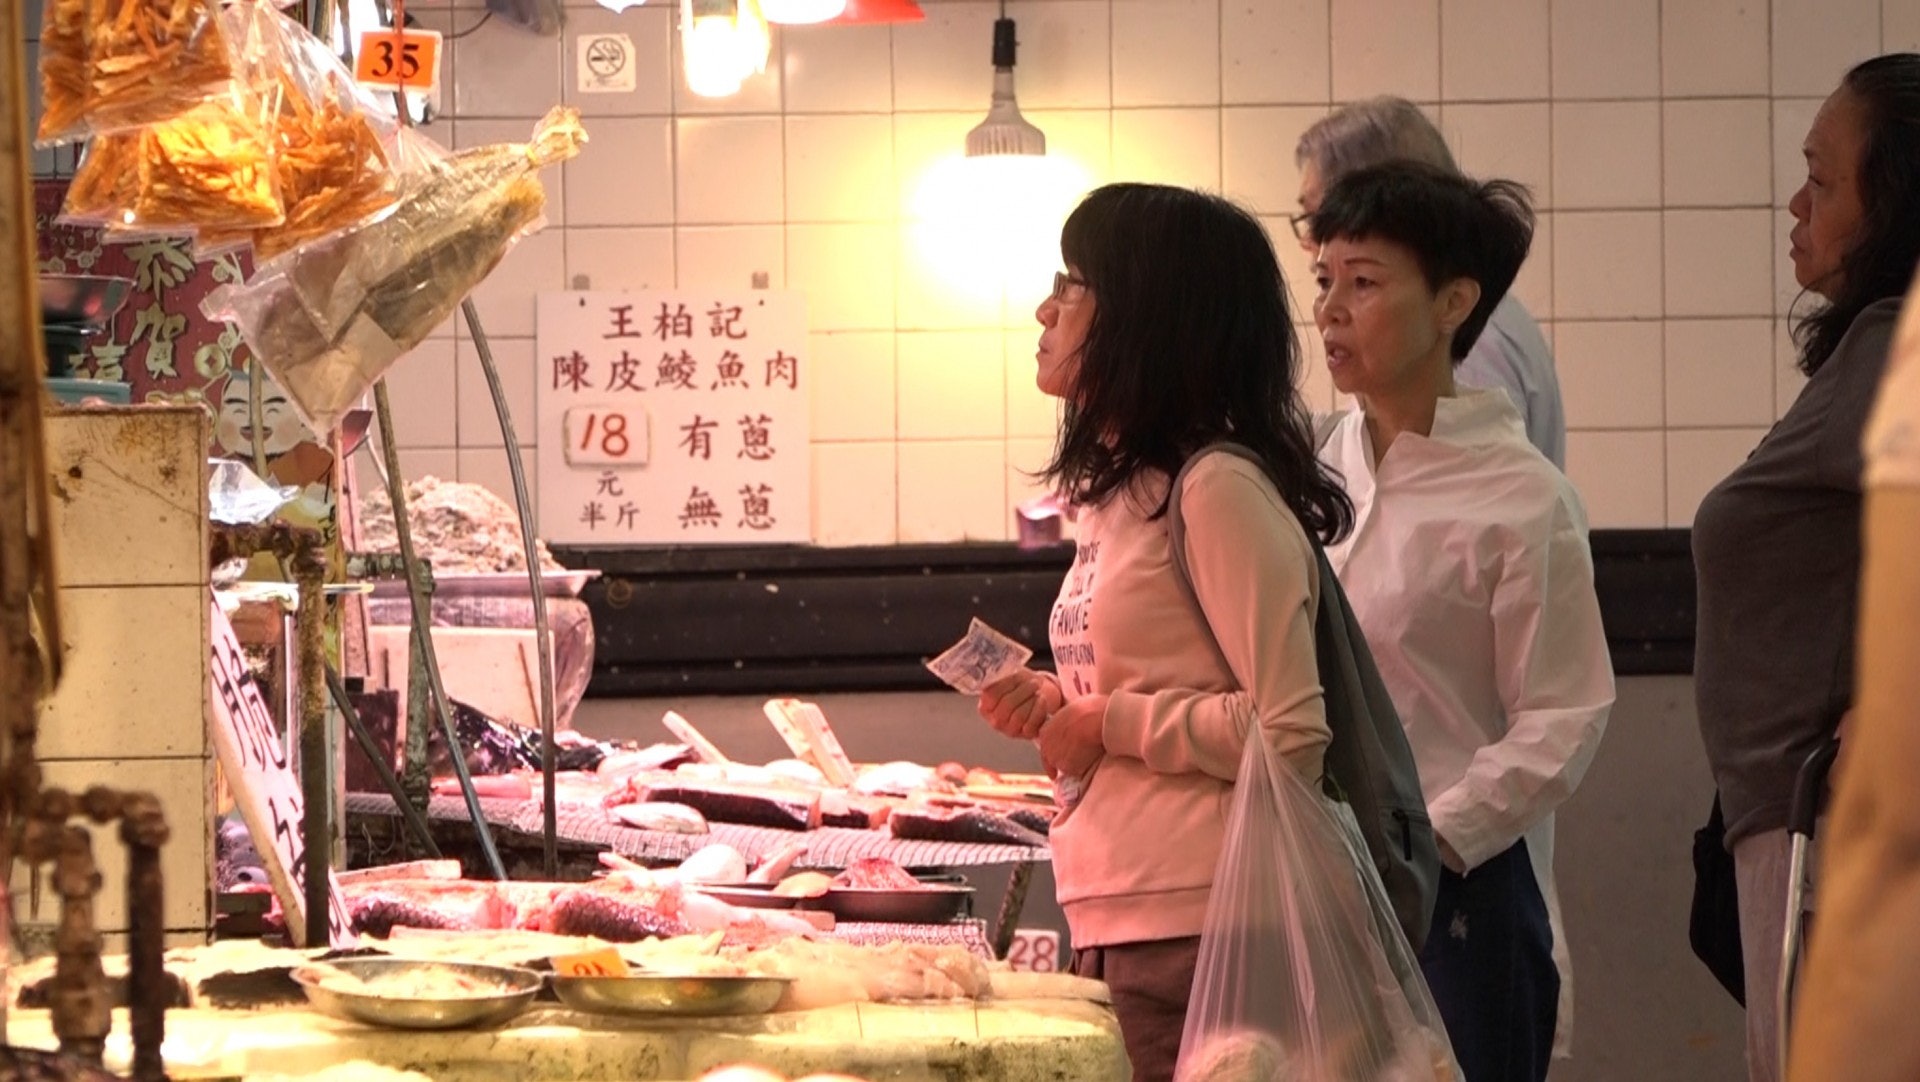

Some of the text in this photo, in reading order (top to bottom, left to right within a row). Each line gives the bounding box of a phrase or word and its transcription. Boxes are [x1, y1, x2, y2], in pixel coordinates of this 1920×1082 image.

[371, 41, 420, 78] 35
[602, 301, 748, 342] 王柏記
[552, 349, 799, 393] 陳皮鯪魚肉
[580, 412, 630, 458] 18
[597, 470, 624, 497] 元
[579, 501, 641, 531] 半斤
[1009, 935, 1056, 973] 28
